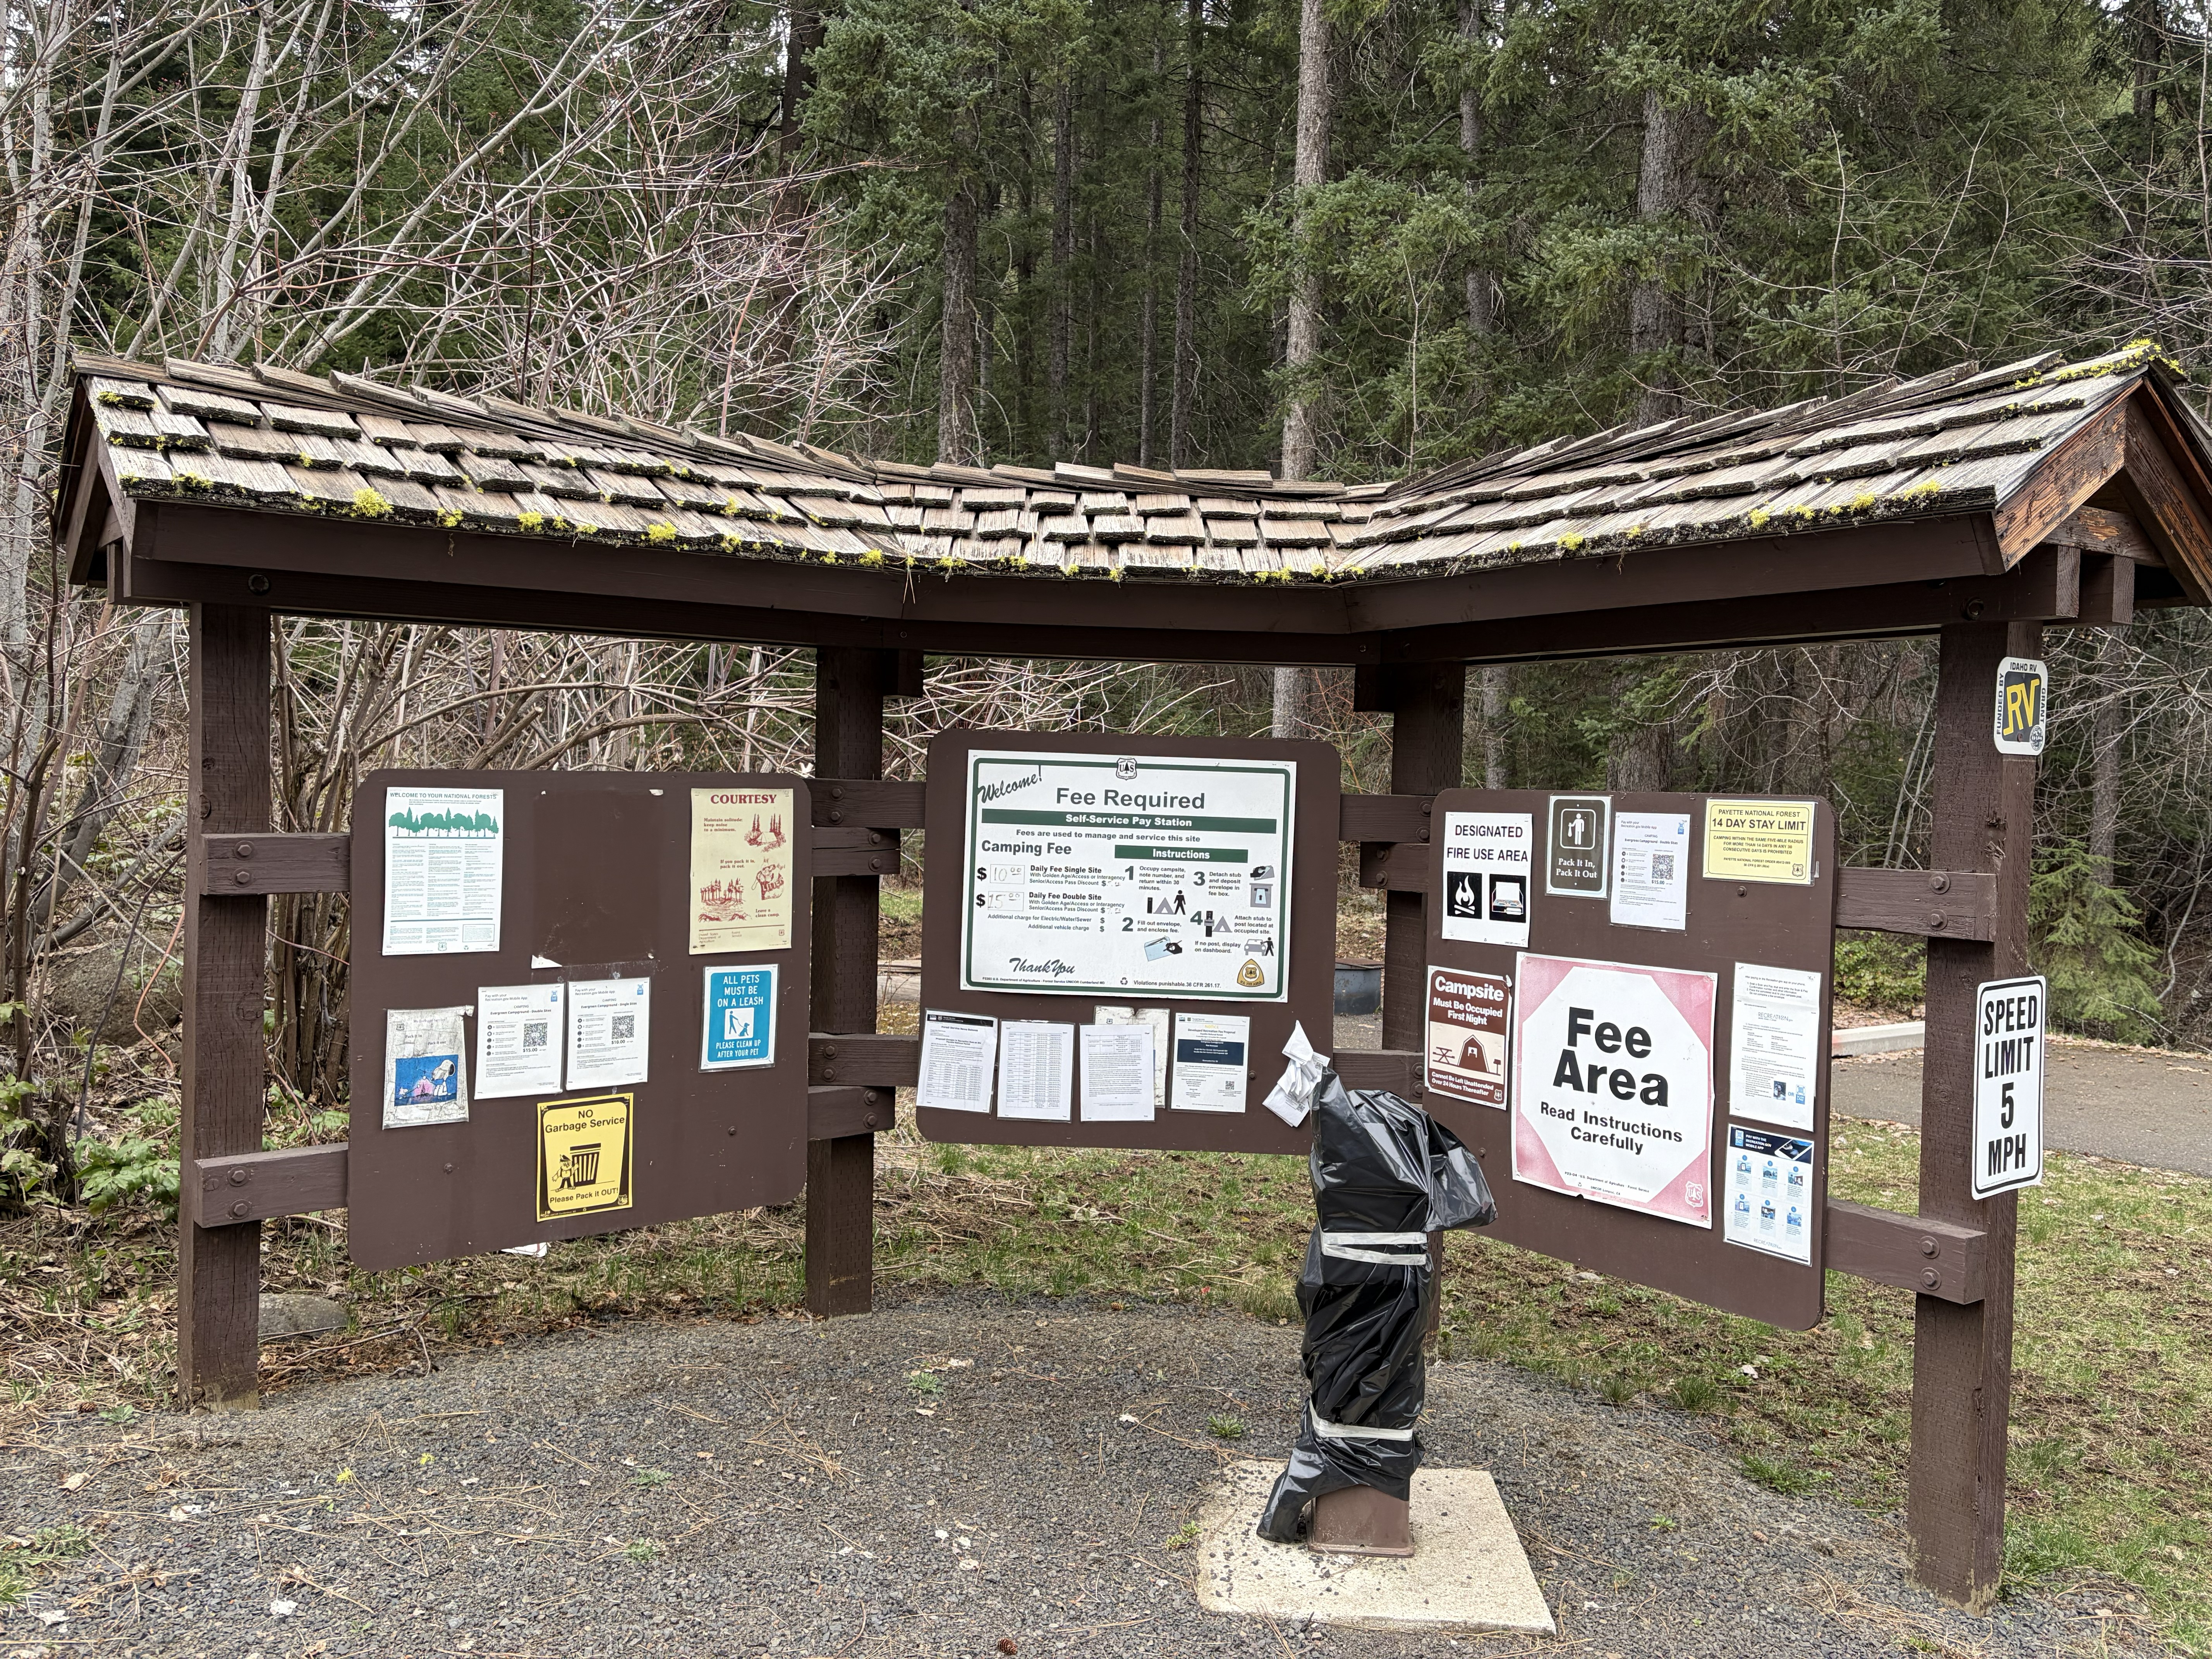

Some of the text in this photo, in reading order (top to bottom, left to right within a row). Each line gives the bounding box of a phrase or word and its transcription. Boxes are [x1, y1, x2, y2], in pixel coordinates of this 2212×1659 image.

[2010, 662, 2028, 671] IDAHO
[1999, 673, 2004, 686] BY
[2003, 678, 2040, 736] RV
[978, 765, 1042, 804] Welcome!
[711, 794, 777, 804] COURTESY
[1057, 788, 1204, 811] Fee Required
[1066, 814, 1192, 827] Self-Service Pay Station
[1712, 818, 1807, 831] 14 DAY STAY LIMIT
[1455, 825, 1523, 838] DESIGNATED
[982, 840, 1072, 856] Camping Fee
[1153, 848, 1210, 859] Instructions
[1447, 847, 1528, 862] FIRE USE AREA
[1558, 858, 1575, 866] Pack
[1585, 860, 1595, 868] In,
[1125, 866, 1133, 880] 1
[1193, 871, 1206, 886] 3
[1556, 868, 1573, 877] Pack
[1121, 917, 1133, 932] 2
[723, 974, 759, 984] ALL PETS
[725, 986, 757, 995] MUST BE
[1435, 976, 1504, 1001] Campsite
[718, 996, 763, 1007] ON A LEASH
[1433, 997, 1503, 1018] Must Be Occupied
[1448, 1010, 1487, 1026] First Night
[1984, 995, 2037, 1036] SPEED
[1568, 1006, 1652, 1058] Fee
[716, 1041, 734, 1049] PLEASE
[717, 1050, 733, 1058] AFTER
[1985, 1036, 2034, 1079] LIMIT
[1432, 1071, 1448, 1080] Cannot
[1455, 1076, 1464, 1084] Left
[1464, 1079, 1494, 1091] Unattended
[1553, 1049, 1669, 1107] Area
[1449, 1082, 1462, 1090] Hours
[1463, 1085, 1489, 1096] Thereafter
[2001, 1082, 2014, 1129] 5
[578, 1109, 593, 1119] NO
[545, 1116, 625, 1133] Garbage Service
[1541, 1102, 1683, 1143] Read Instructions
[1571, 1127, 1643, 1156] Carefully
[1988, 1133, 2026, 1177] MPH
[601, 1187, 618, 1196] OUT!
